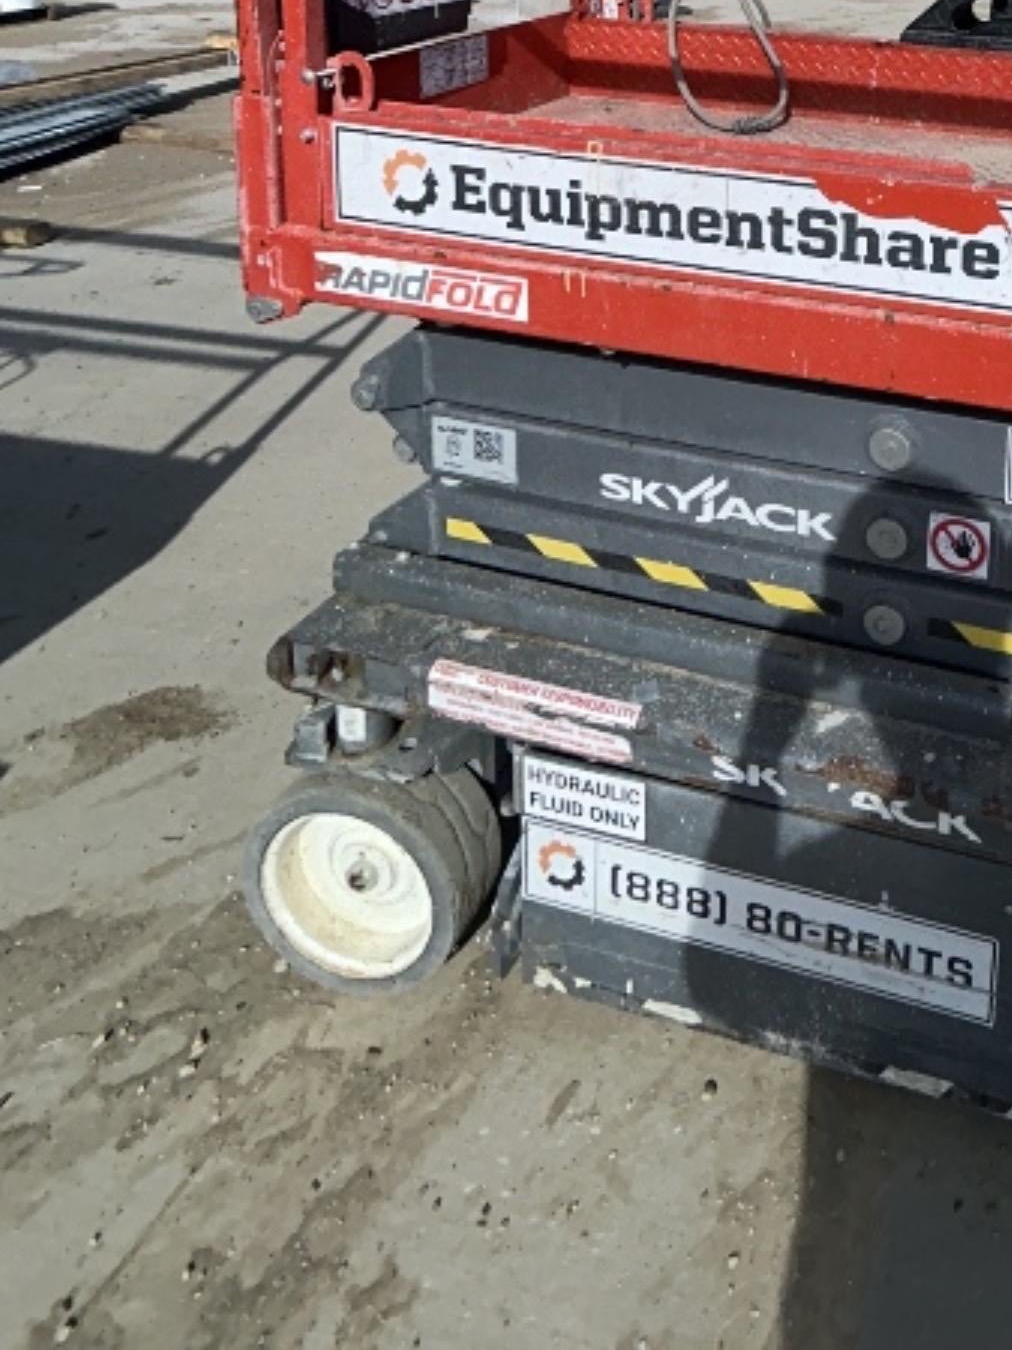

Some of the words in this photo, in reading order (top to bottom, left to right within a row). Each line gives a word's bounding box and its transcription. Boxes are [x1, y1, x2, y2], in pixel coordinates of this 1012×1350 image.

[450, 165, 1000, 279] EquipmentShare
[600, 473, 836, 540] SKYJACK
[527, 764, 641, 805] HYDRAULIC
[530, 792, 583, 817] FLUID
[590, 807, 641, 830] ONLY
[611, 863, 727, 925] (888)
[746, 902, 974, 988] 80-RENTS
